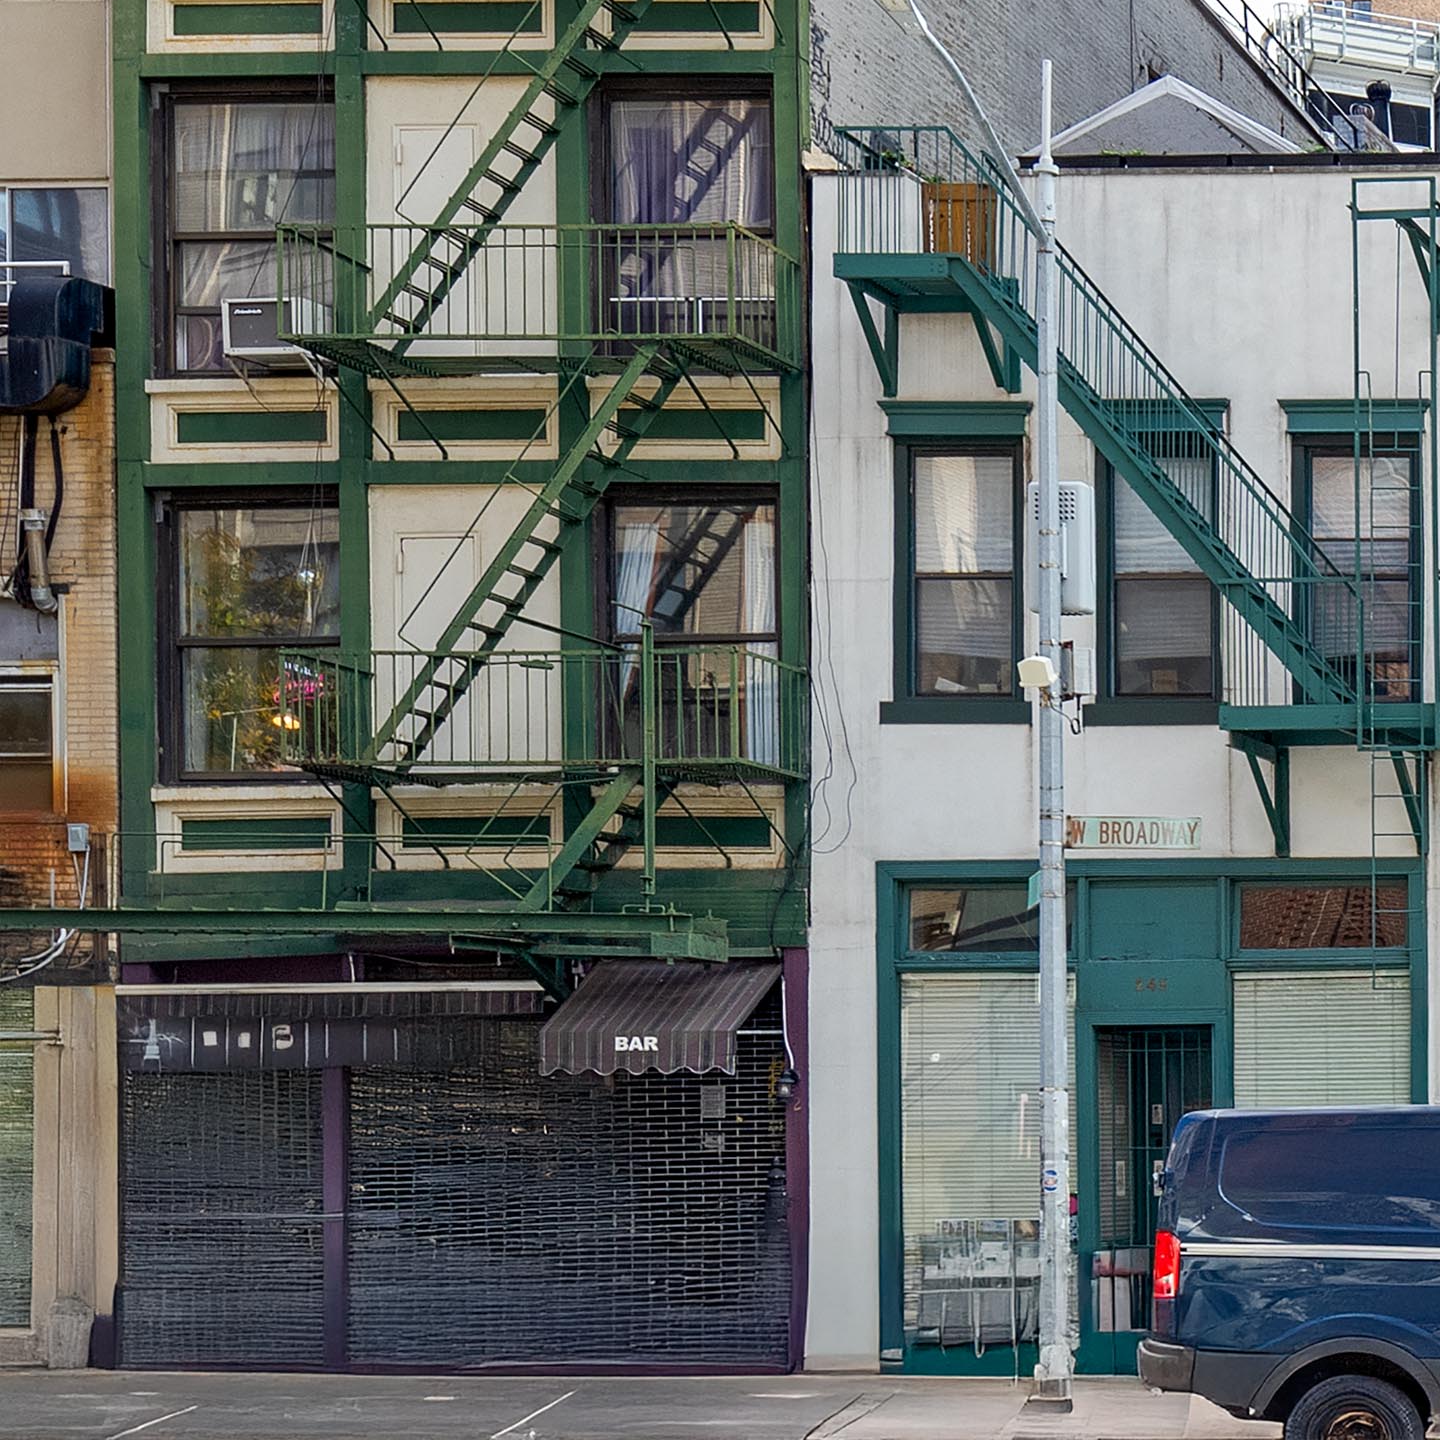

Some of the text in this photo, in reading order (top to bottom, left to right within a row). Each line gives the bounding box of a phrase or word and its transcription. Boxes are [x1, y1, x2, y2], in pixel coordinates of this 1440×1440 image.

[1071, 821, 1199, 845] W BROADWAY
[614, 1036, 659, 1052] BAR
